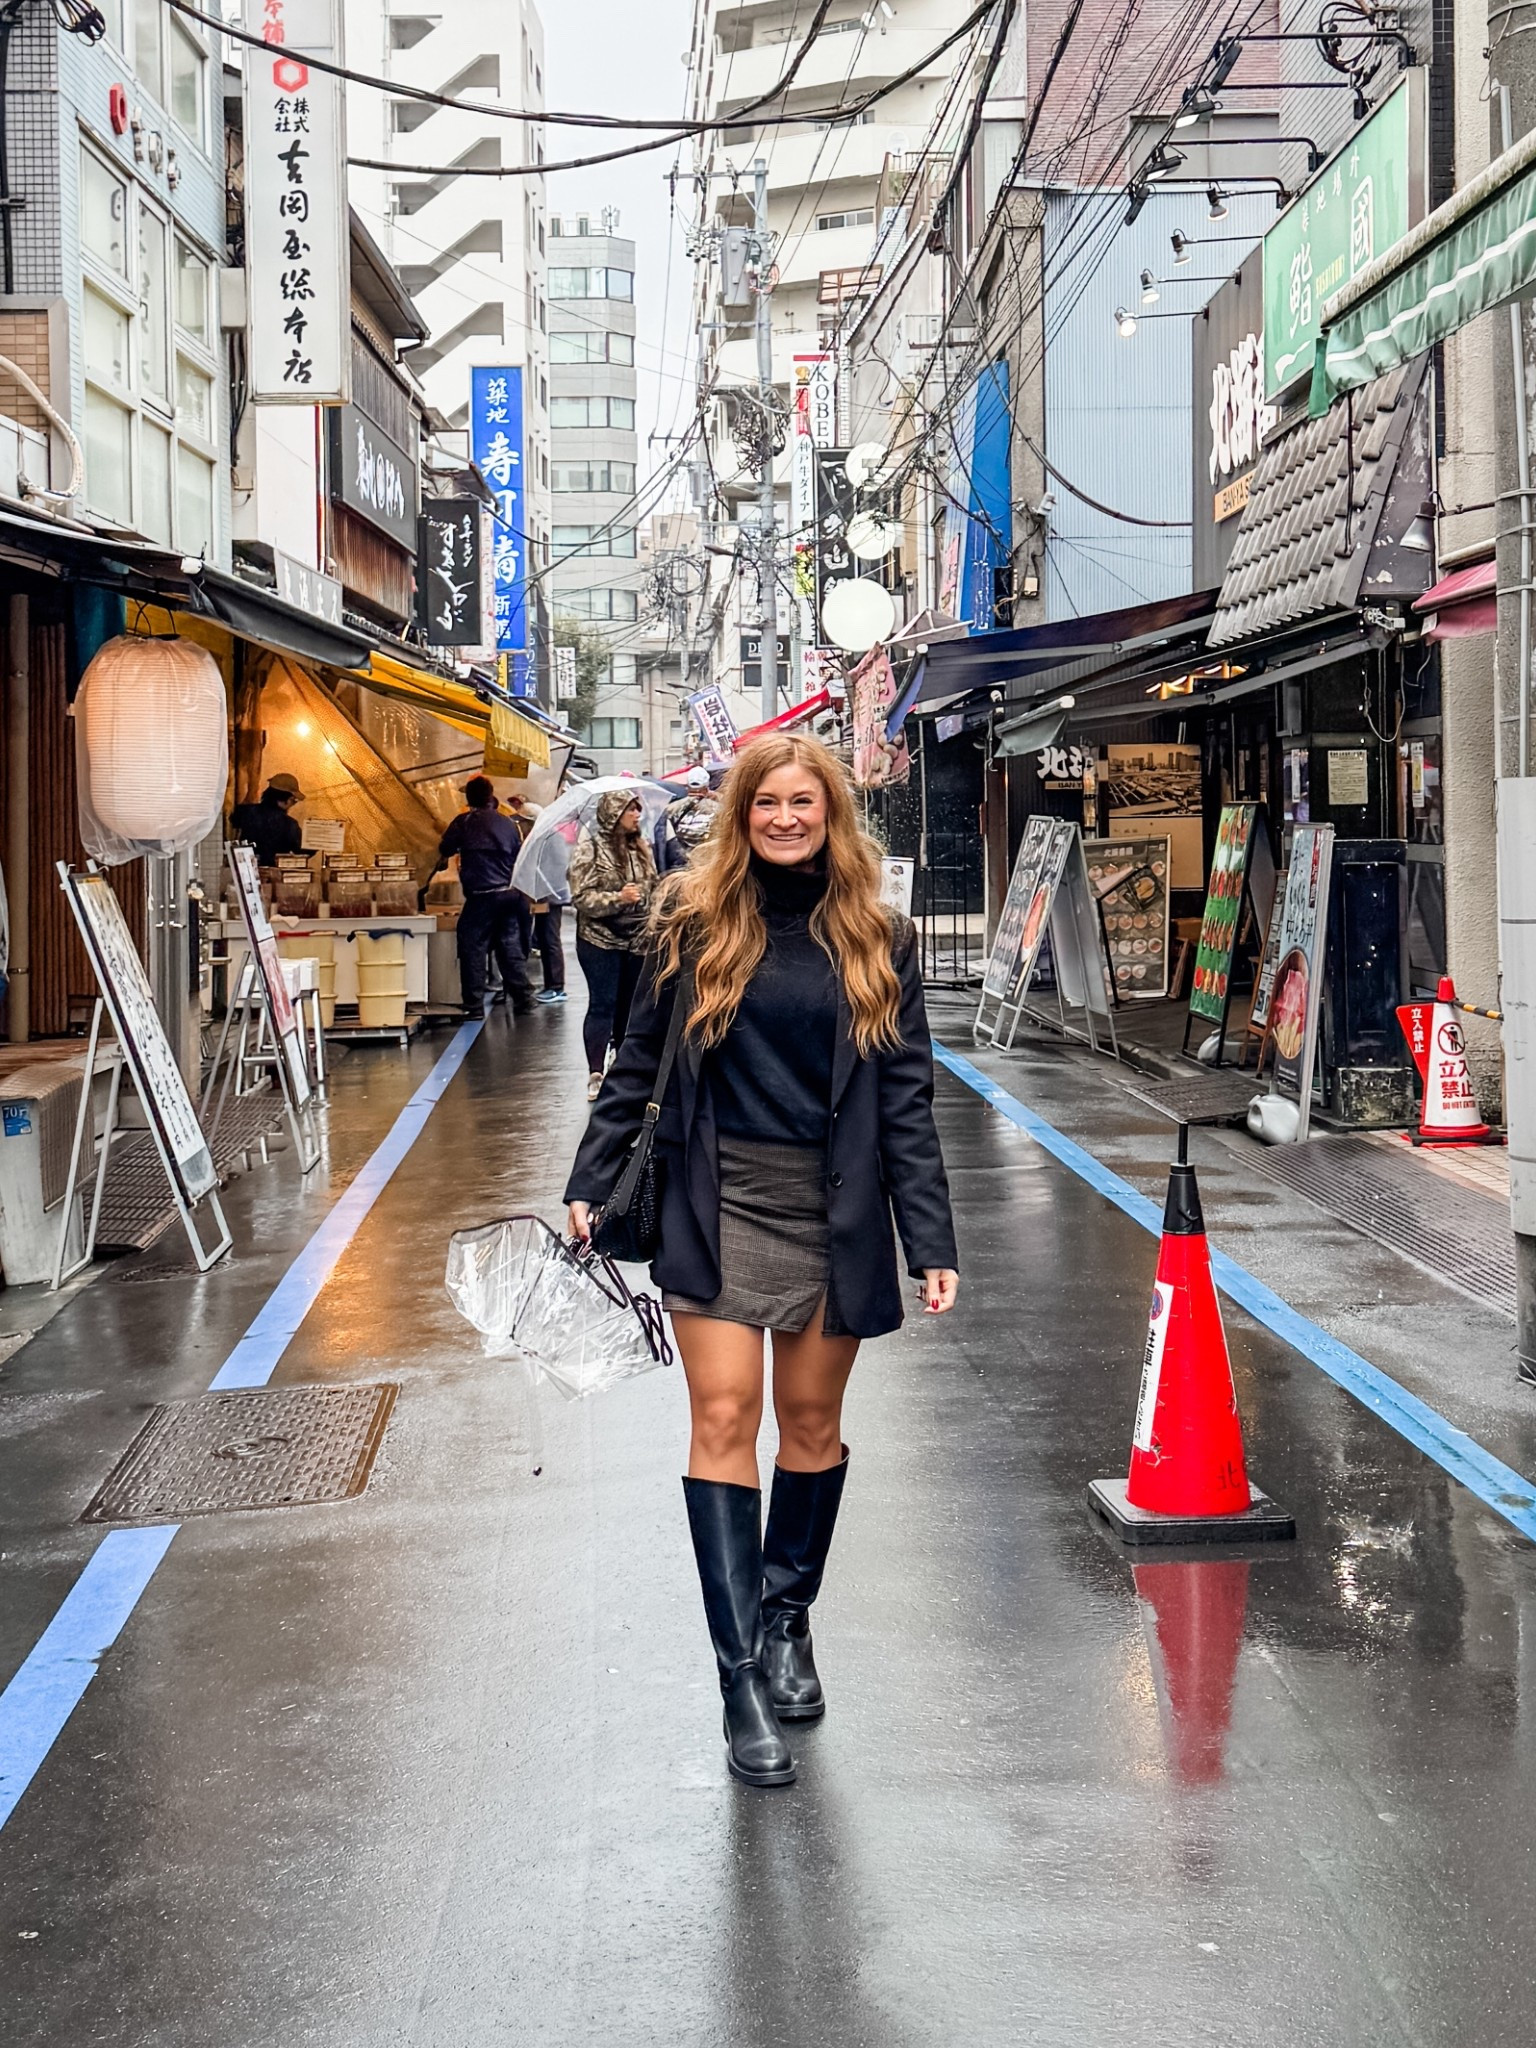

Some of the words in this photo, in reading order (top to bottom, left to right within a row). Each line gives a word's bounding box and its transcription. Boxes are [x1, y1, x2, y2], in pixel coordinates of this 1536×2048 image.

[278, 139, 315, 384] 吉岡屋総本店
[485, 377, 510, 423] 築地
[1411, 1007, 1425, 1053] 立入禁止
[1439, 1060, 1471, 1079] 立入
[1441, 1081, 1475, 1099] 禁止
